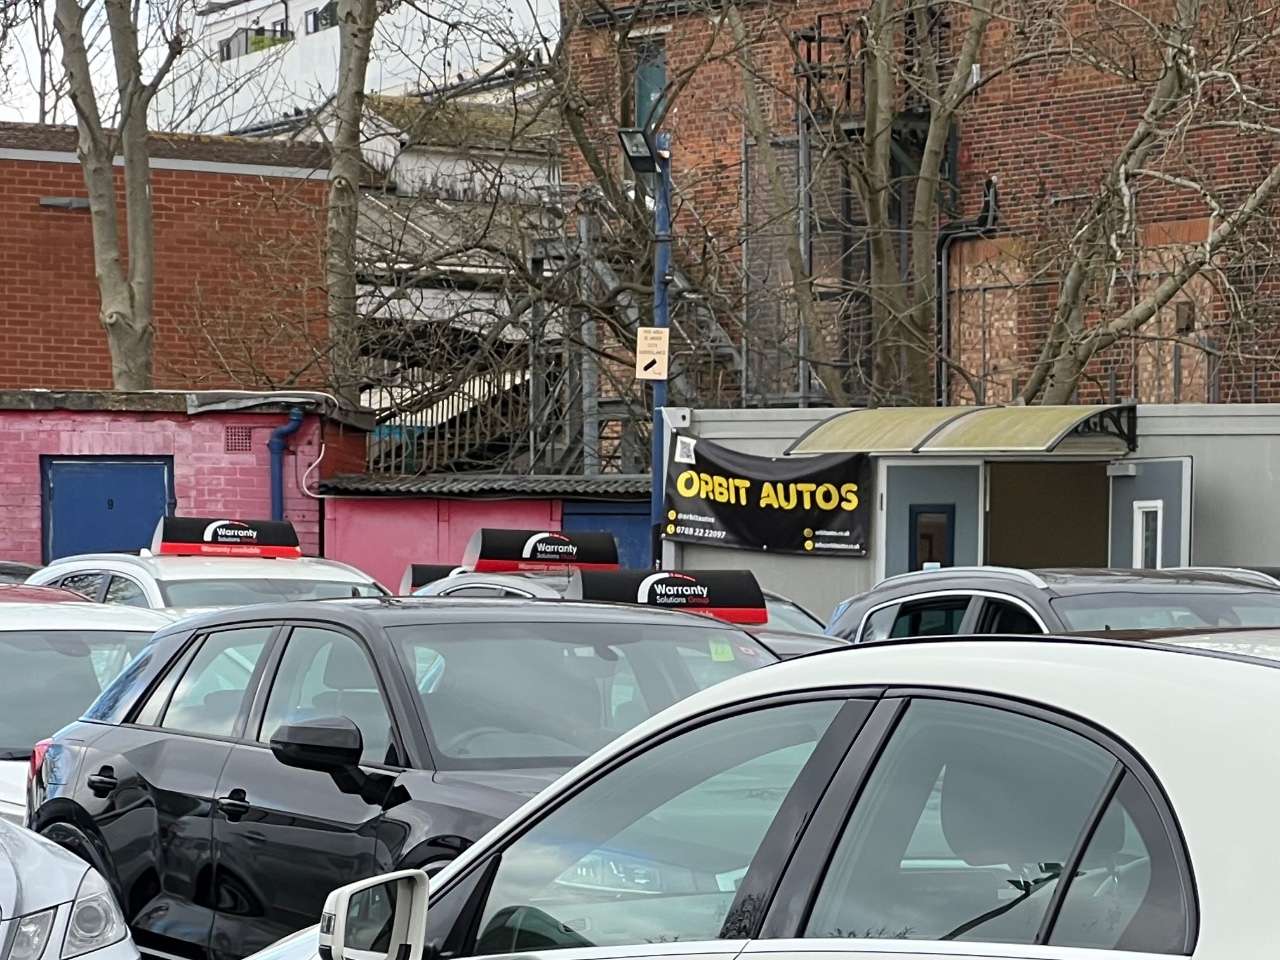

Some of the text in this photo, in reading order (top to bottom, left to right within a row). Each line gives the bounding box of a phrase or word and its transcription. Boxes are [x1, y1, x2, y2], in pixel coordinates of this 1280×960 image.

[677, 470, 859, 511] ORBIT AUTOS
[216, 527, 257, 538] Warranty
[694, 528, 704, 537] 22
[536, 542, 577, 554] Warranty
[654, 584, 708, 597] Warranty
[656, 595, 686, 604] Solutions
